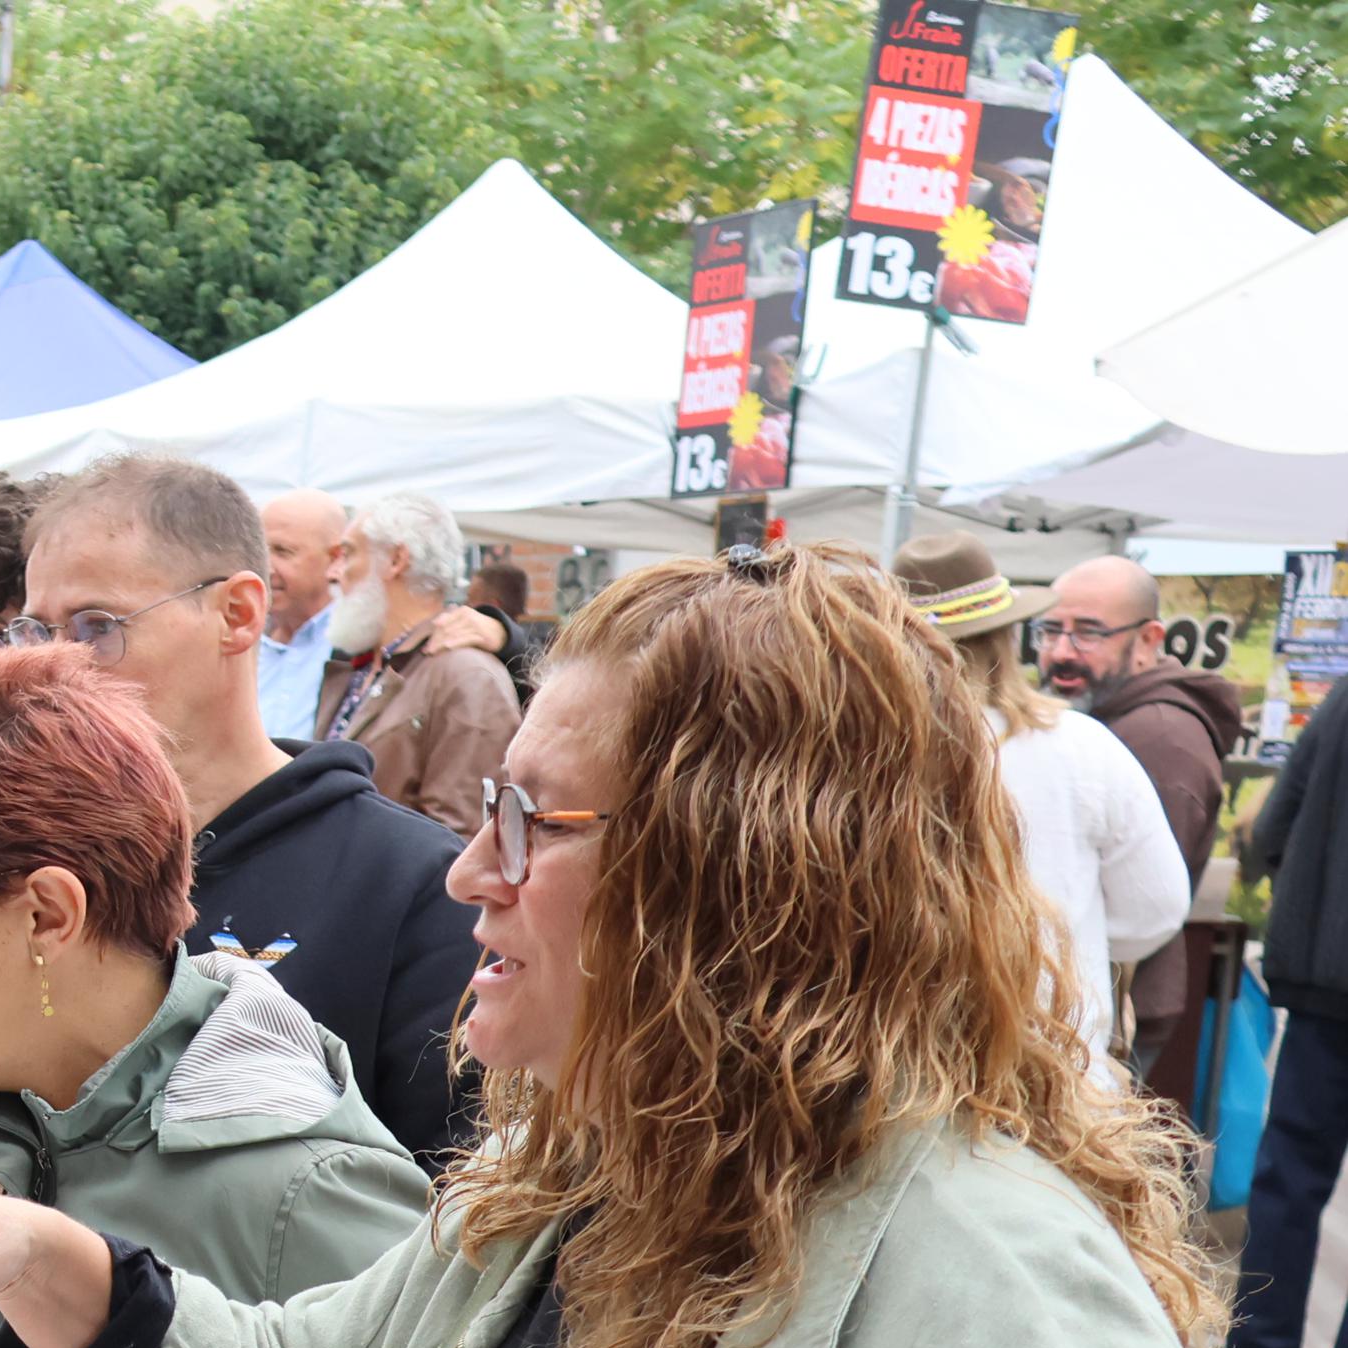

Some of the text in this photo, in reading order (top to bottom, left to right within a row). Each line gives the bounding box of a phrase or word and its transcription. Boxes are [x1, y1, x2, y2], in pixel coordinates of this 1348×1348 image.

[878, 44, 969, 93] OFERTA
[868, 97, 968, 156] 4 PIEZAS
